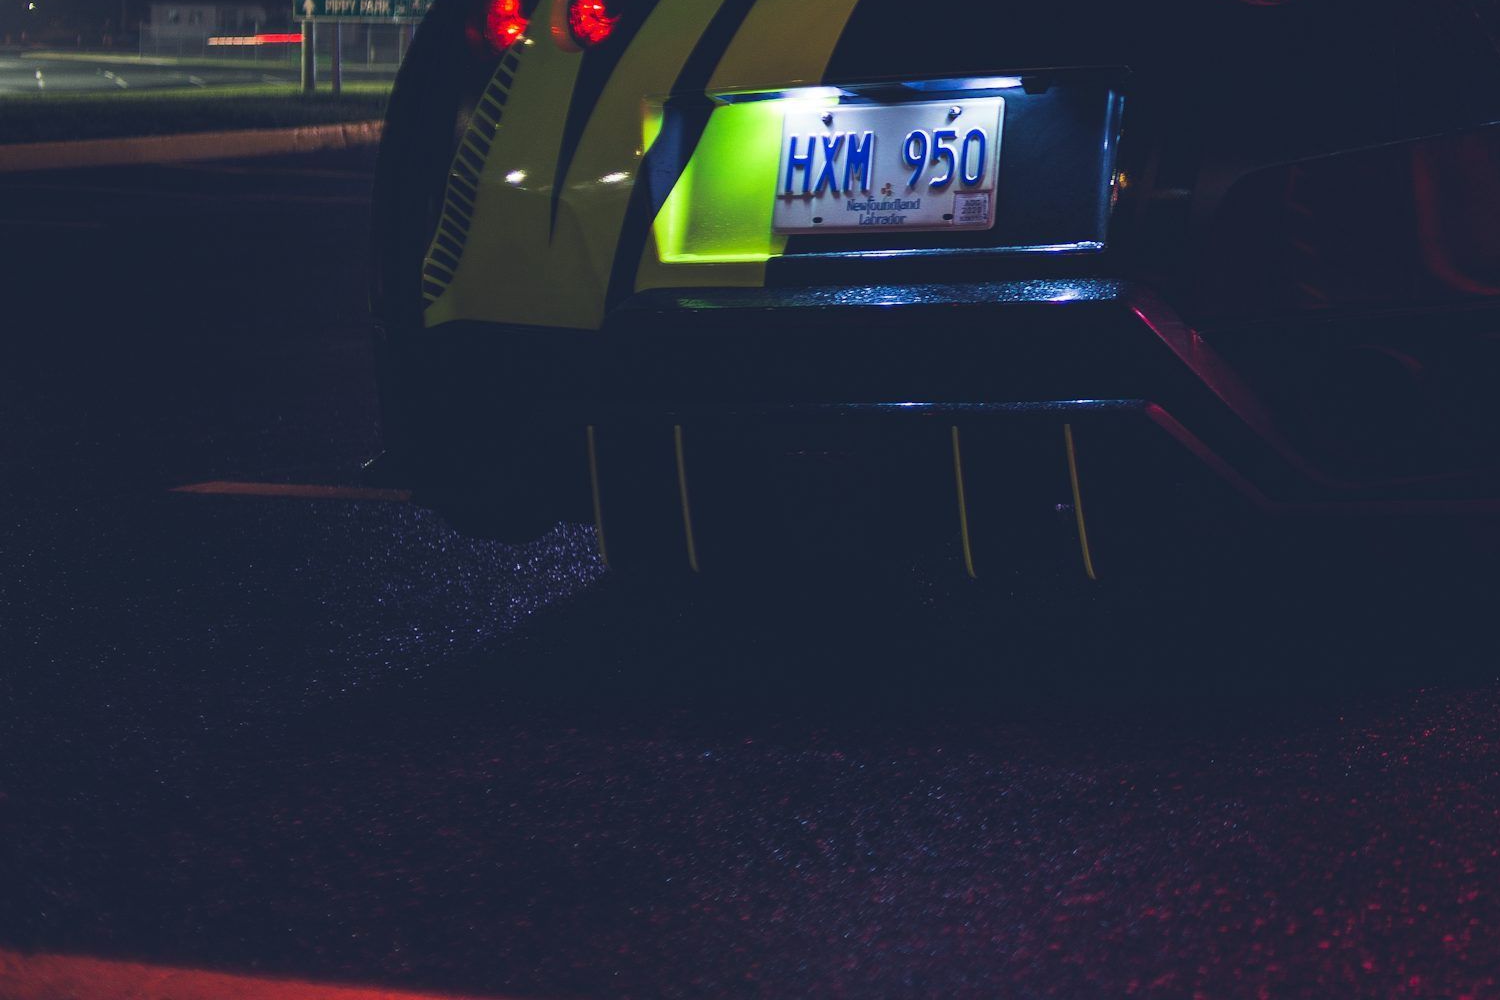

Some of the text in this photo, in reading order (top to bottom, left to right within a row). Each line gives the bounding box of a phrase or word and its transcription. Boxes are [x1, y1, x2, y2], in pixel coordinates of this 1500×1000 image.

[785, 127, 990, 194] HXM 950
[846, 196, 921, 214] Newfoundland
[858, 212, 907, 225] Labrador
